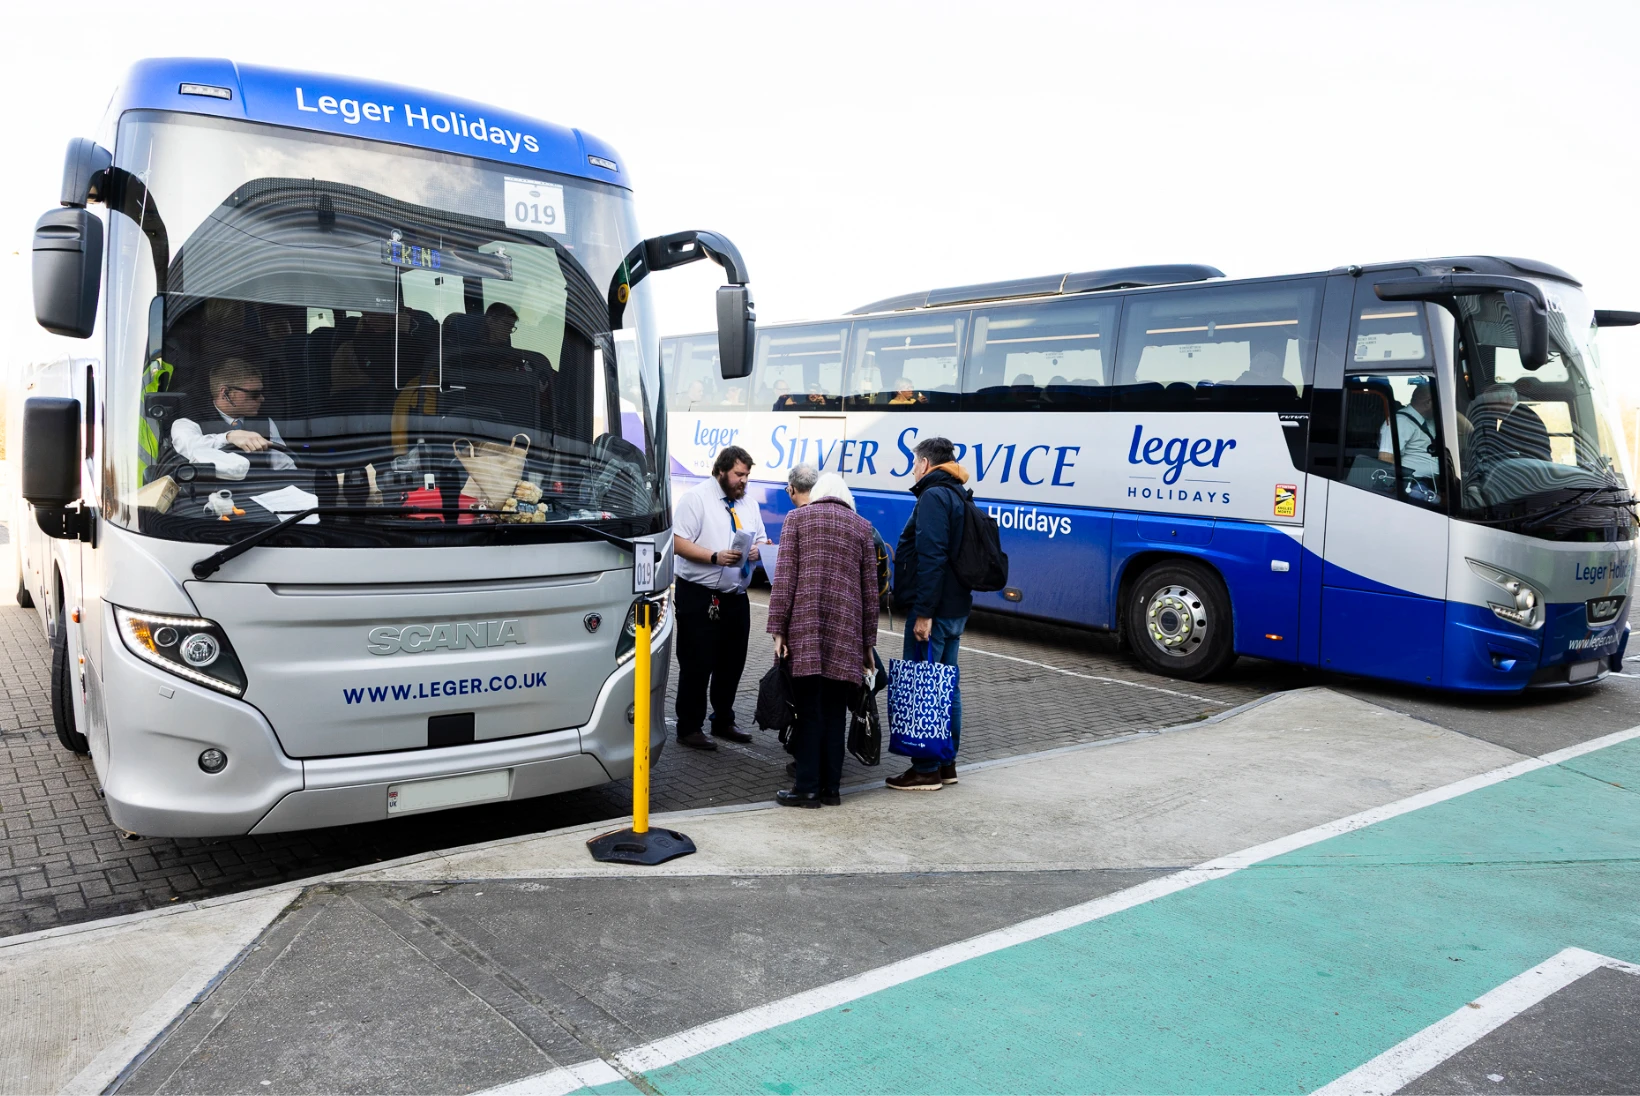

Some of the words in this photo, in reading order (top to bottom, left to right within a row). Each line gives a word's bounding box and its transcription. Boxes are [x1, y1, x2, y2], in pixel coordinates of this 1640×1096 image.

[295, 87, 395, 125] Leger
[404, 104, 540, 154] Holidays
[515, 201, 556, 226] 019
[694, 419, 739, 459] leger
[1128, 424, 1237, 486] leger
[889, 427, 1081, 488] SVICE
[1127, 487, 1231, 504] HOLIDAYS
[988, 505, 1072, 539] Holidays
[637, 562, 652, 586] 019
[1575, 562, 1607, 584] Leger
[1592, 600, 1617, 618] VDL
[367, 619, 527, 656] SCANIA
[343, 671, 548, 705] WWW.LEGER.CO.UK
